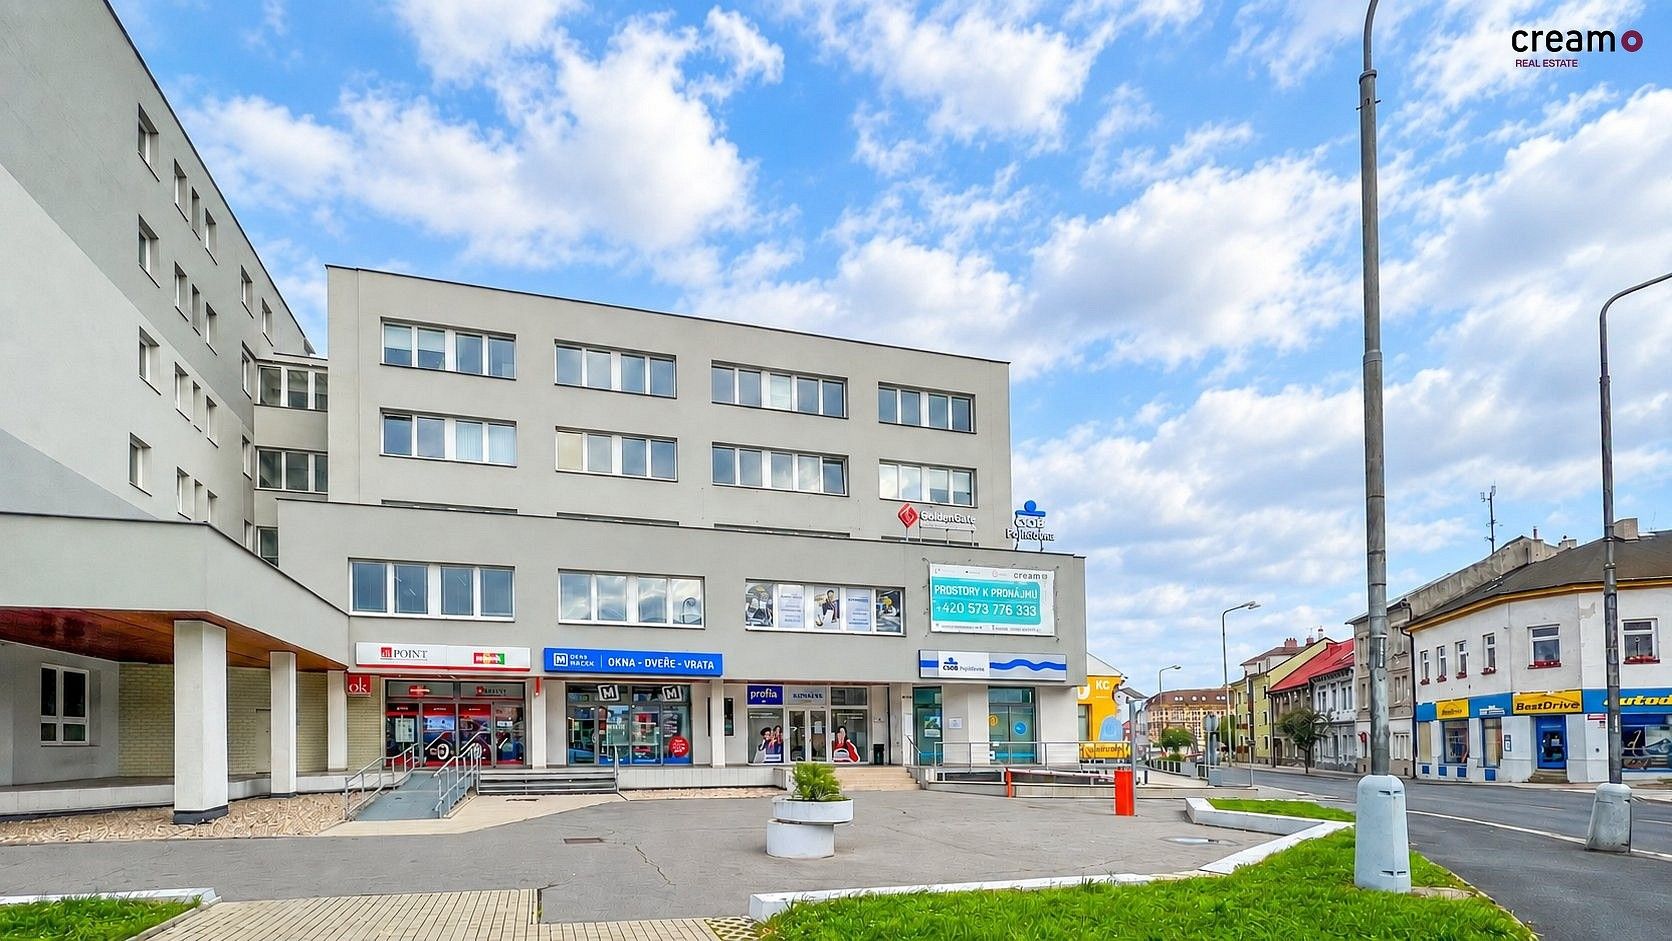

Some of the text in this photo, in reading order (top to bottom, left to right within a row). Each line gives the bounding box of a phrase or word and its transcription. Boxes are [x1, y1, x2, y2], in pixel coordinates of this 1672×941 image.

[934, 585, 980, 596] PROSTORY
[983, 588, 989, 597] K
[991, 587, 1038, 599] PRONÁJMU
[936, 602, 1037, 617] +420 573 776 333
[394, 650, 428, 659] POINT
[608, 657, 635, 667] OKNA
[644, 656, 676, 669] DVEŘE
[684, 660, 715, 670] VRATA
[349, 677, 367, 693] ok
[750, 688, 778, 700] profia
[1515, 700, 1580, 711] BestDrive
